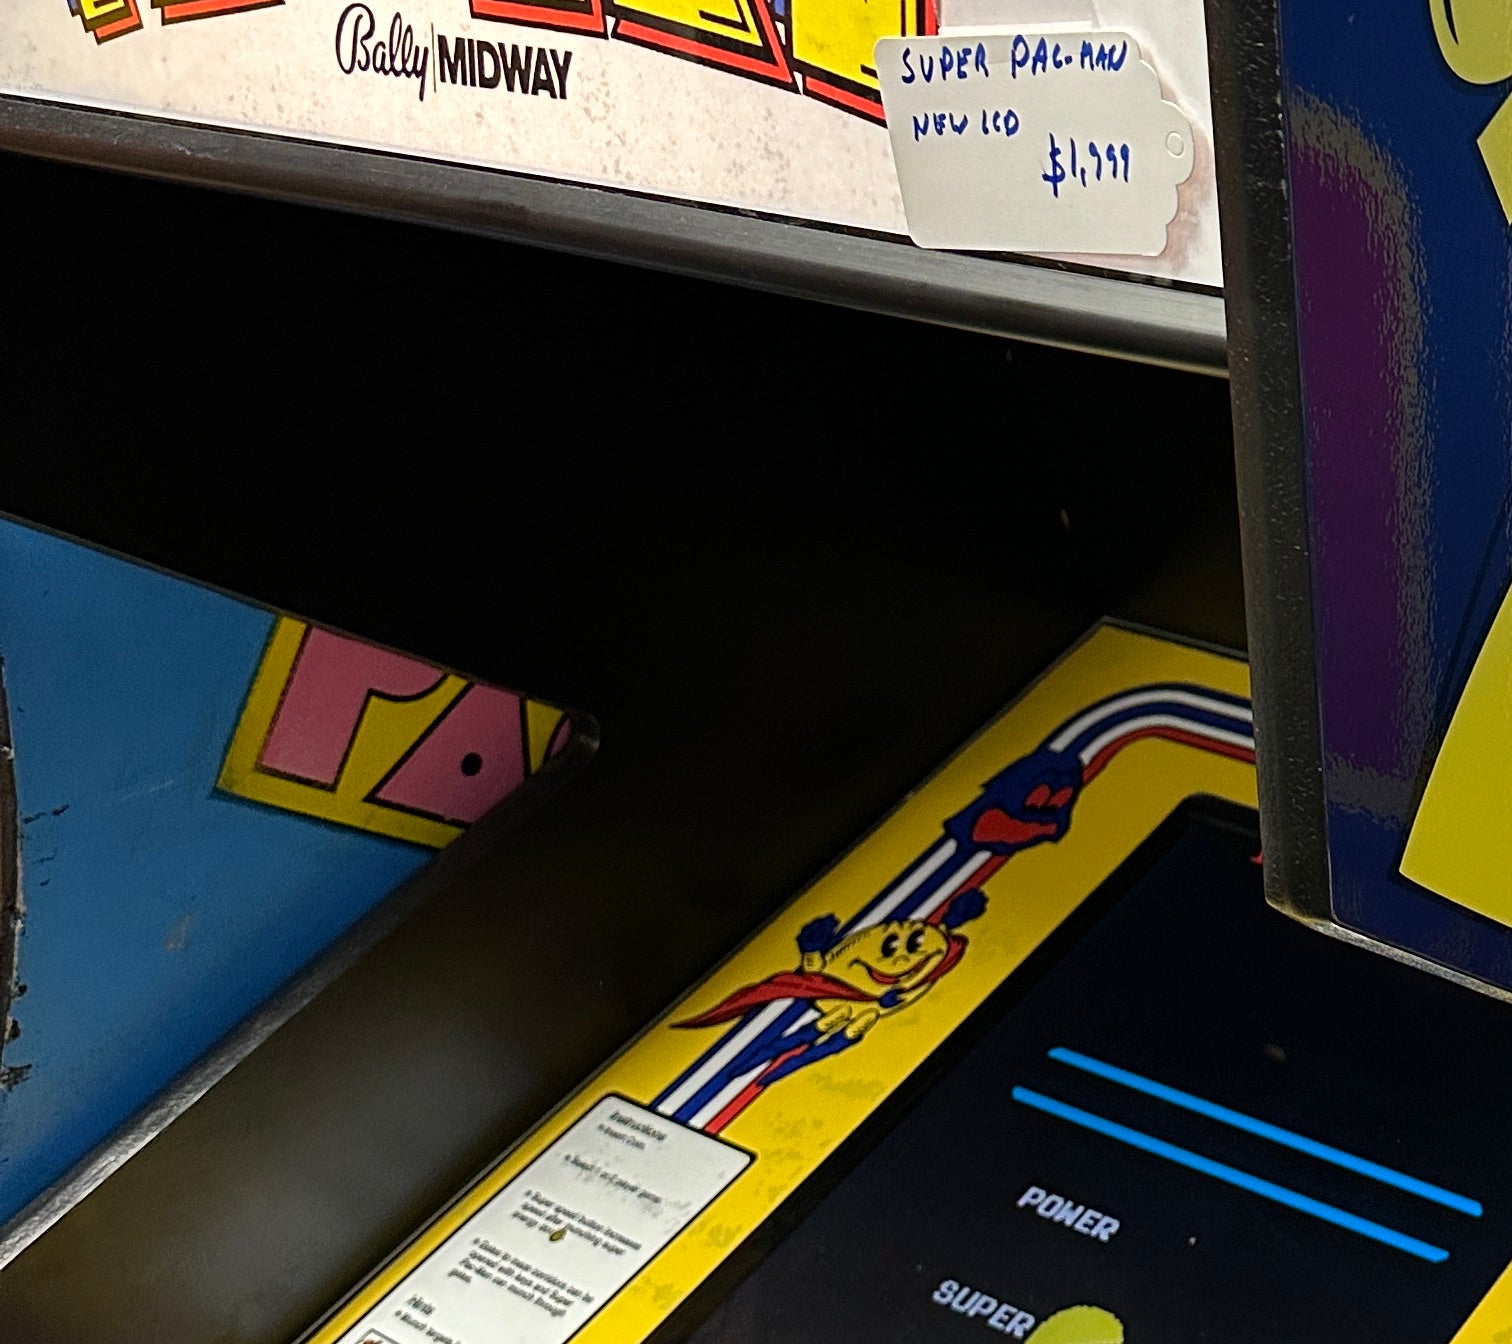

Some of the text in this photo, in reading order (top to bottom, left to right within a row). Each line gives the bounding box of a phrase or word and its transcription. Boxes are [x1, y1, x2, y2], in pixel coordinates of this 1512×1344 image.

[336, 2, 573, 102] Bally MIDWAY
[901, 42, 990, 83] SUPER
[912, 109, 1020, 141] NEW LCD
[1042, 132, 1130, 198] $1,999
[1016, 1186, 1120, 1243] POWER
[932, 1279, 1035, 1340] SUPER
